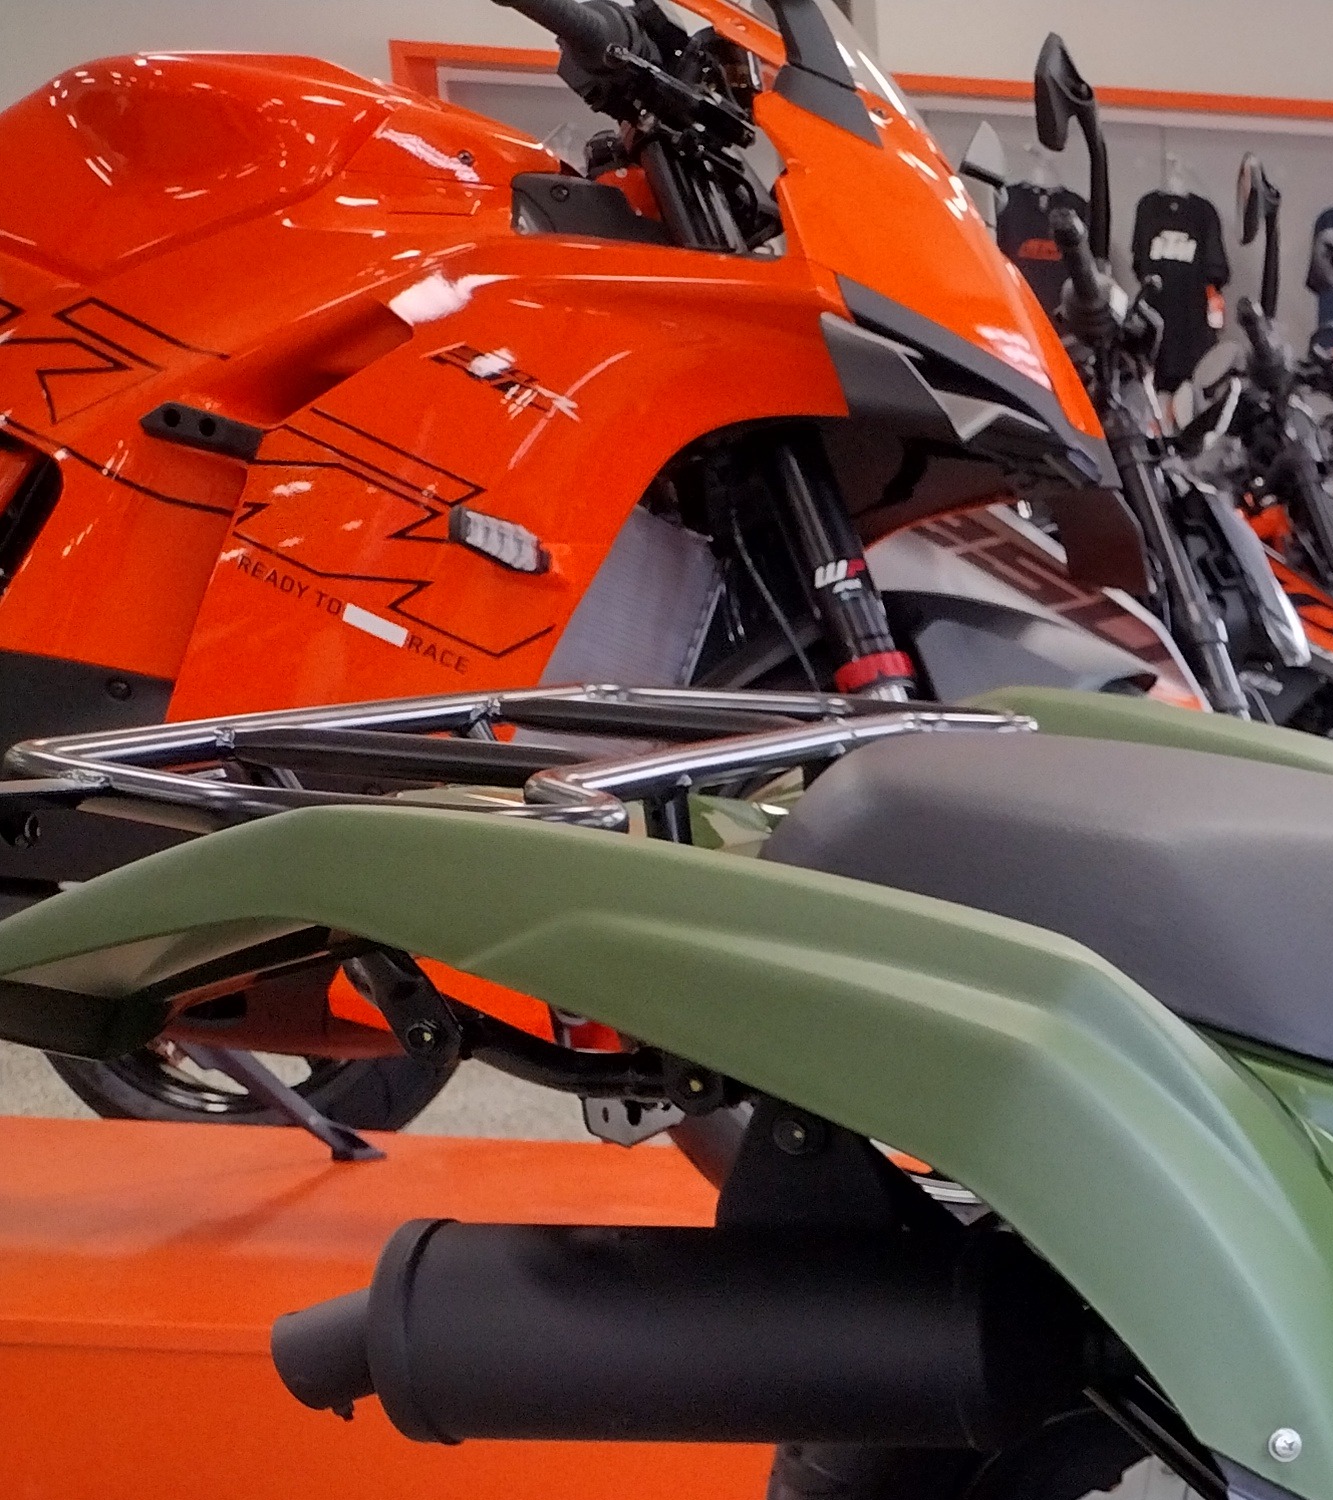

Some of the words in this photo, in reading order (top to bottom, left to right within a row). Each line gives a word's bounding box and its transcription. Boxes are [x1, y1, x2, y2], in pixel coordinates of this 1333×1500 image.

[236, 554, 310, 599] READY
[315, 590, 344, 617] TO
[406, 633, 471, 674] RACE
